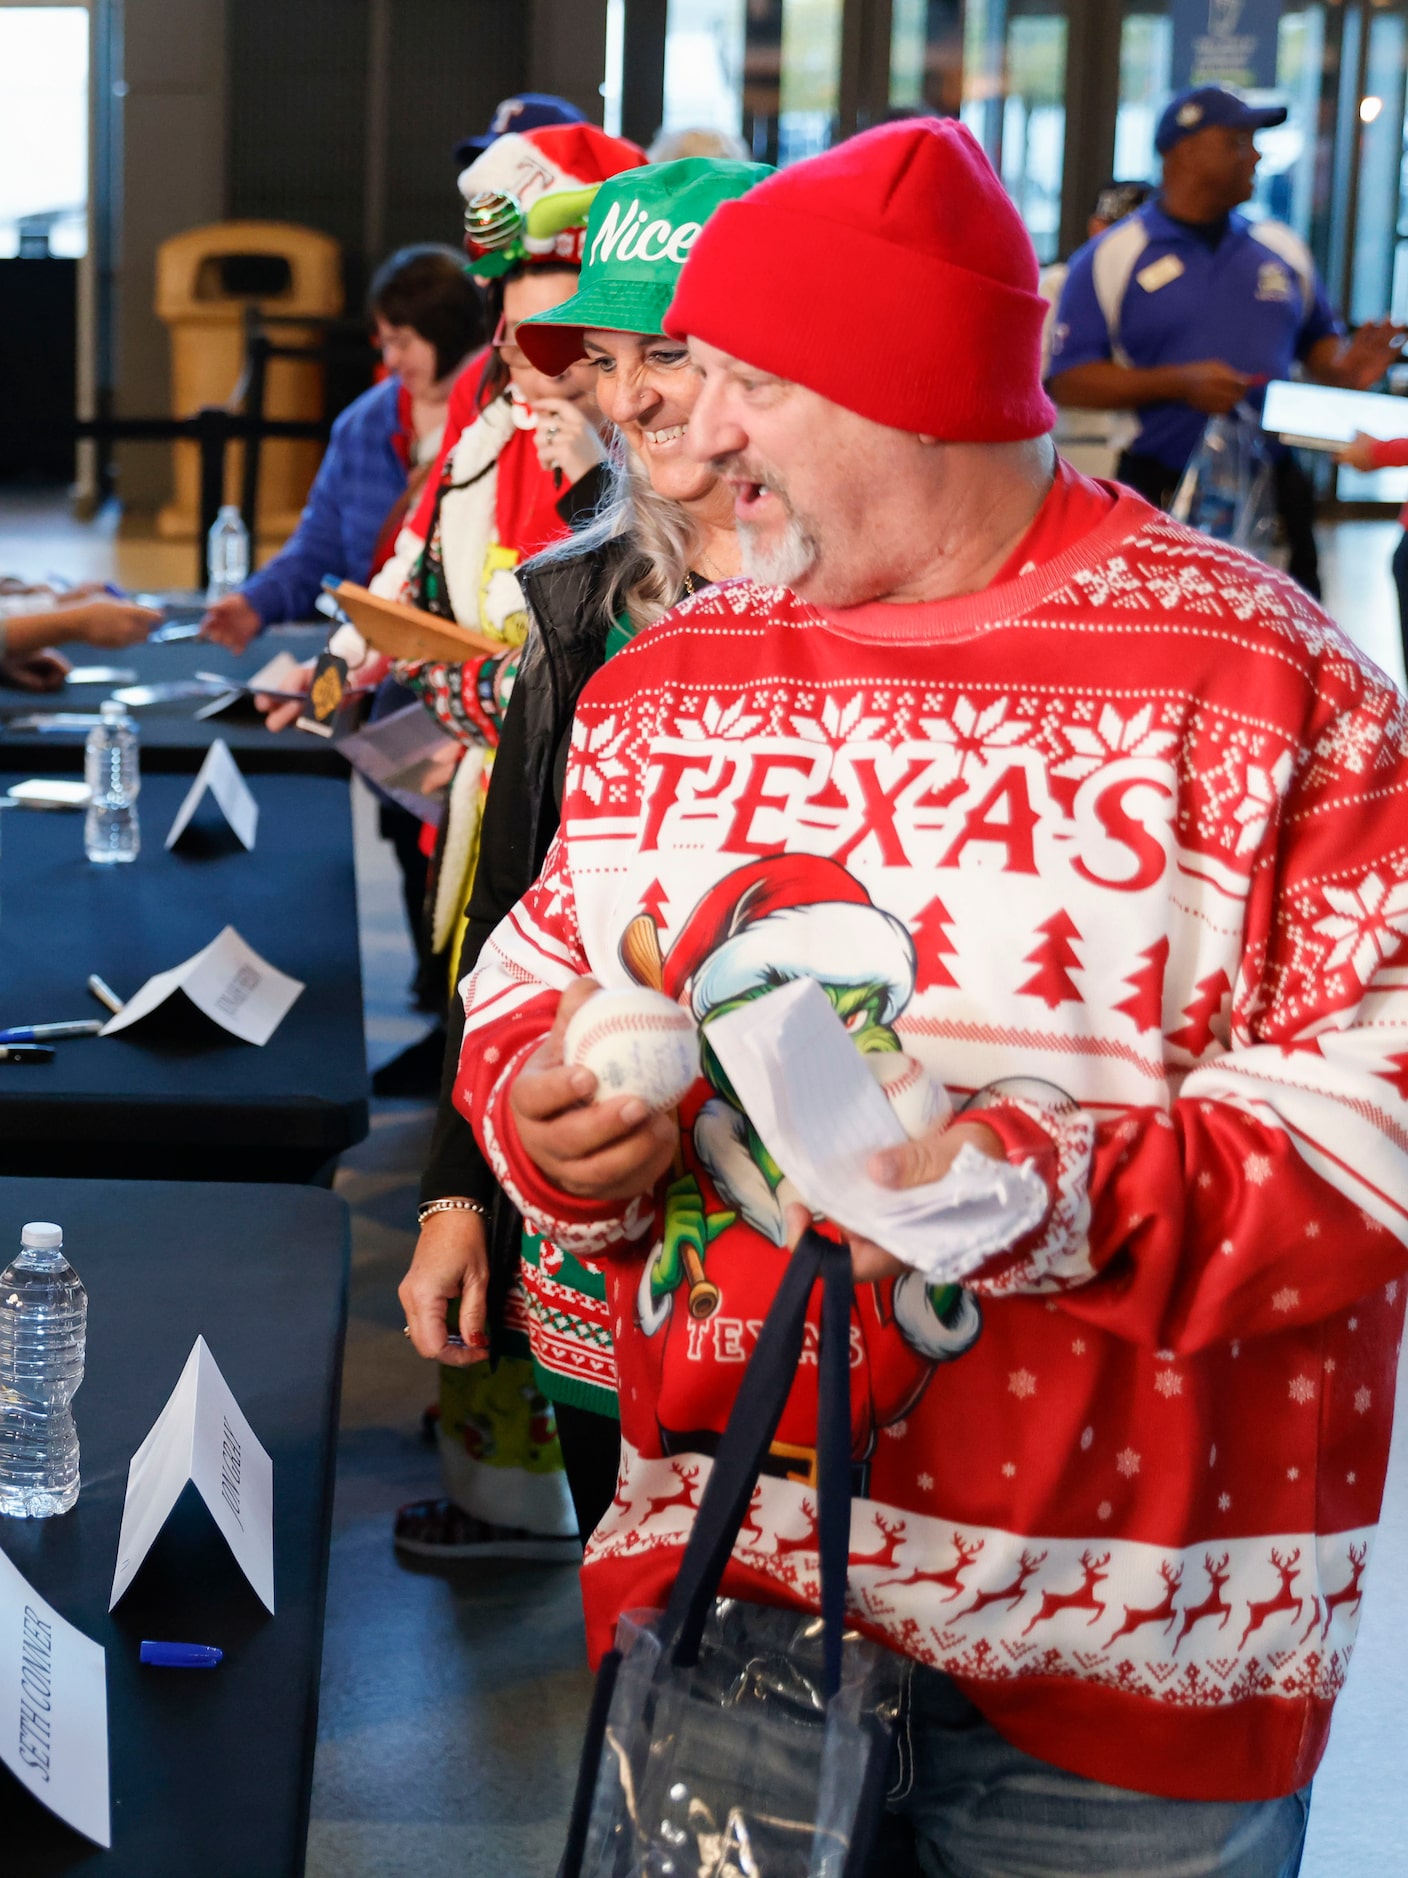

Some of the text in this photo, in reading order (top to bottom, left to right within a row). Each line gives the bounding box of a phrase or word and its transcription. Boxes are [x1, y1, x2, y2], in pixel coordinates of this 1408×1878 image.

[589, 198, 704, 268] Nice
[638, 750, 1174, 893] TEXAS
[222, 1415, 244, 1533] JON GRAY
[19, 1604, 52, 1783] SETH CONNER
